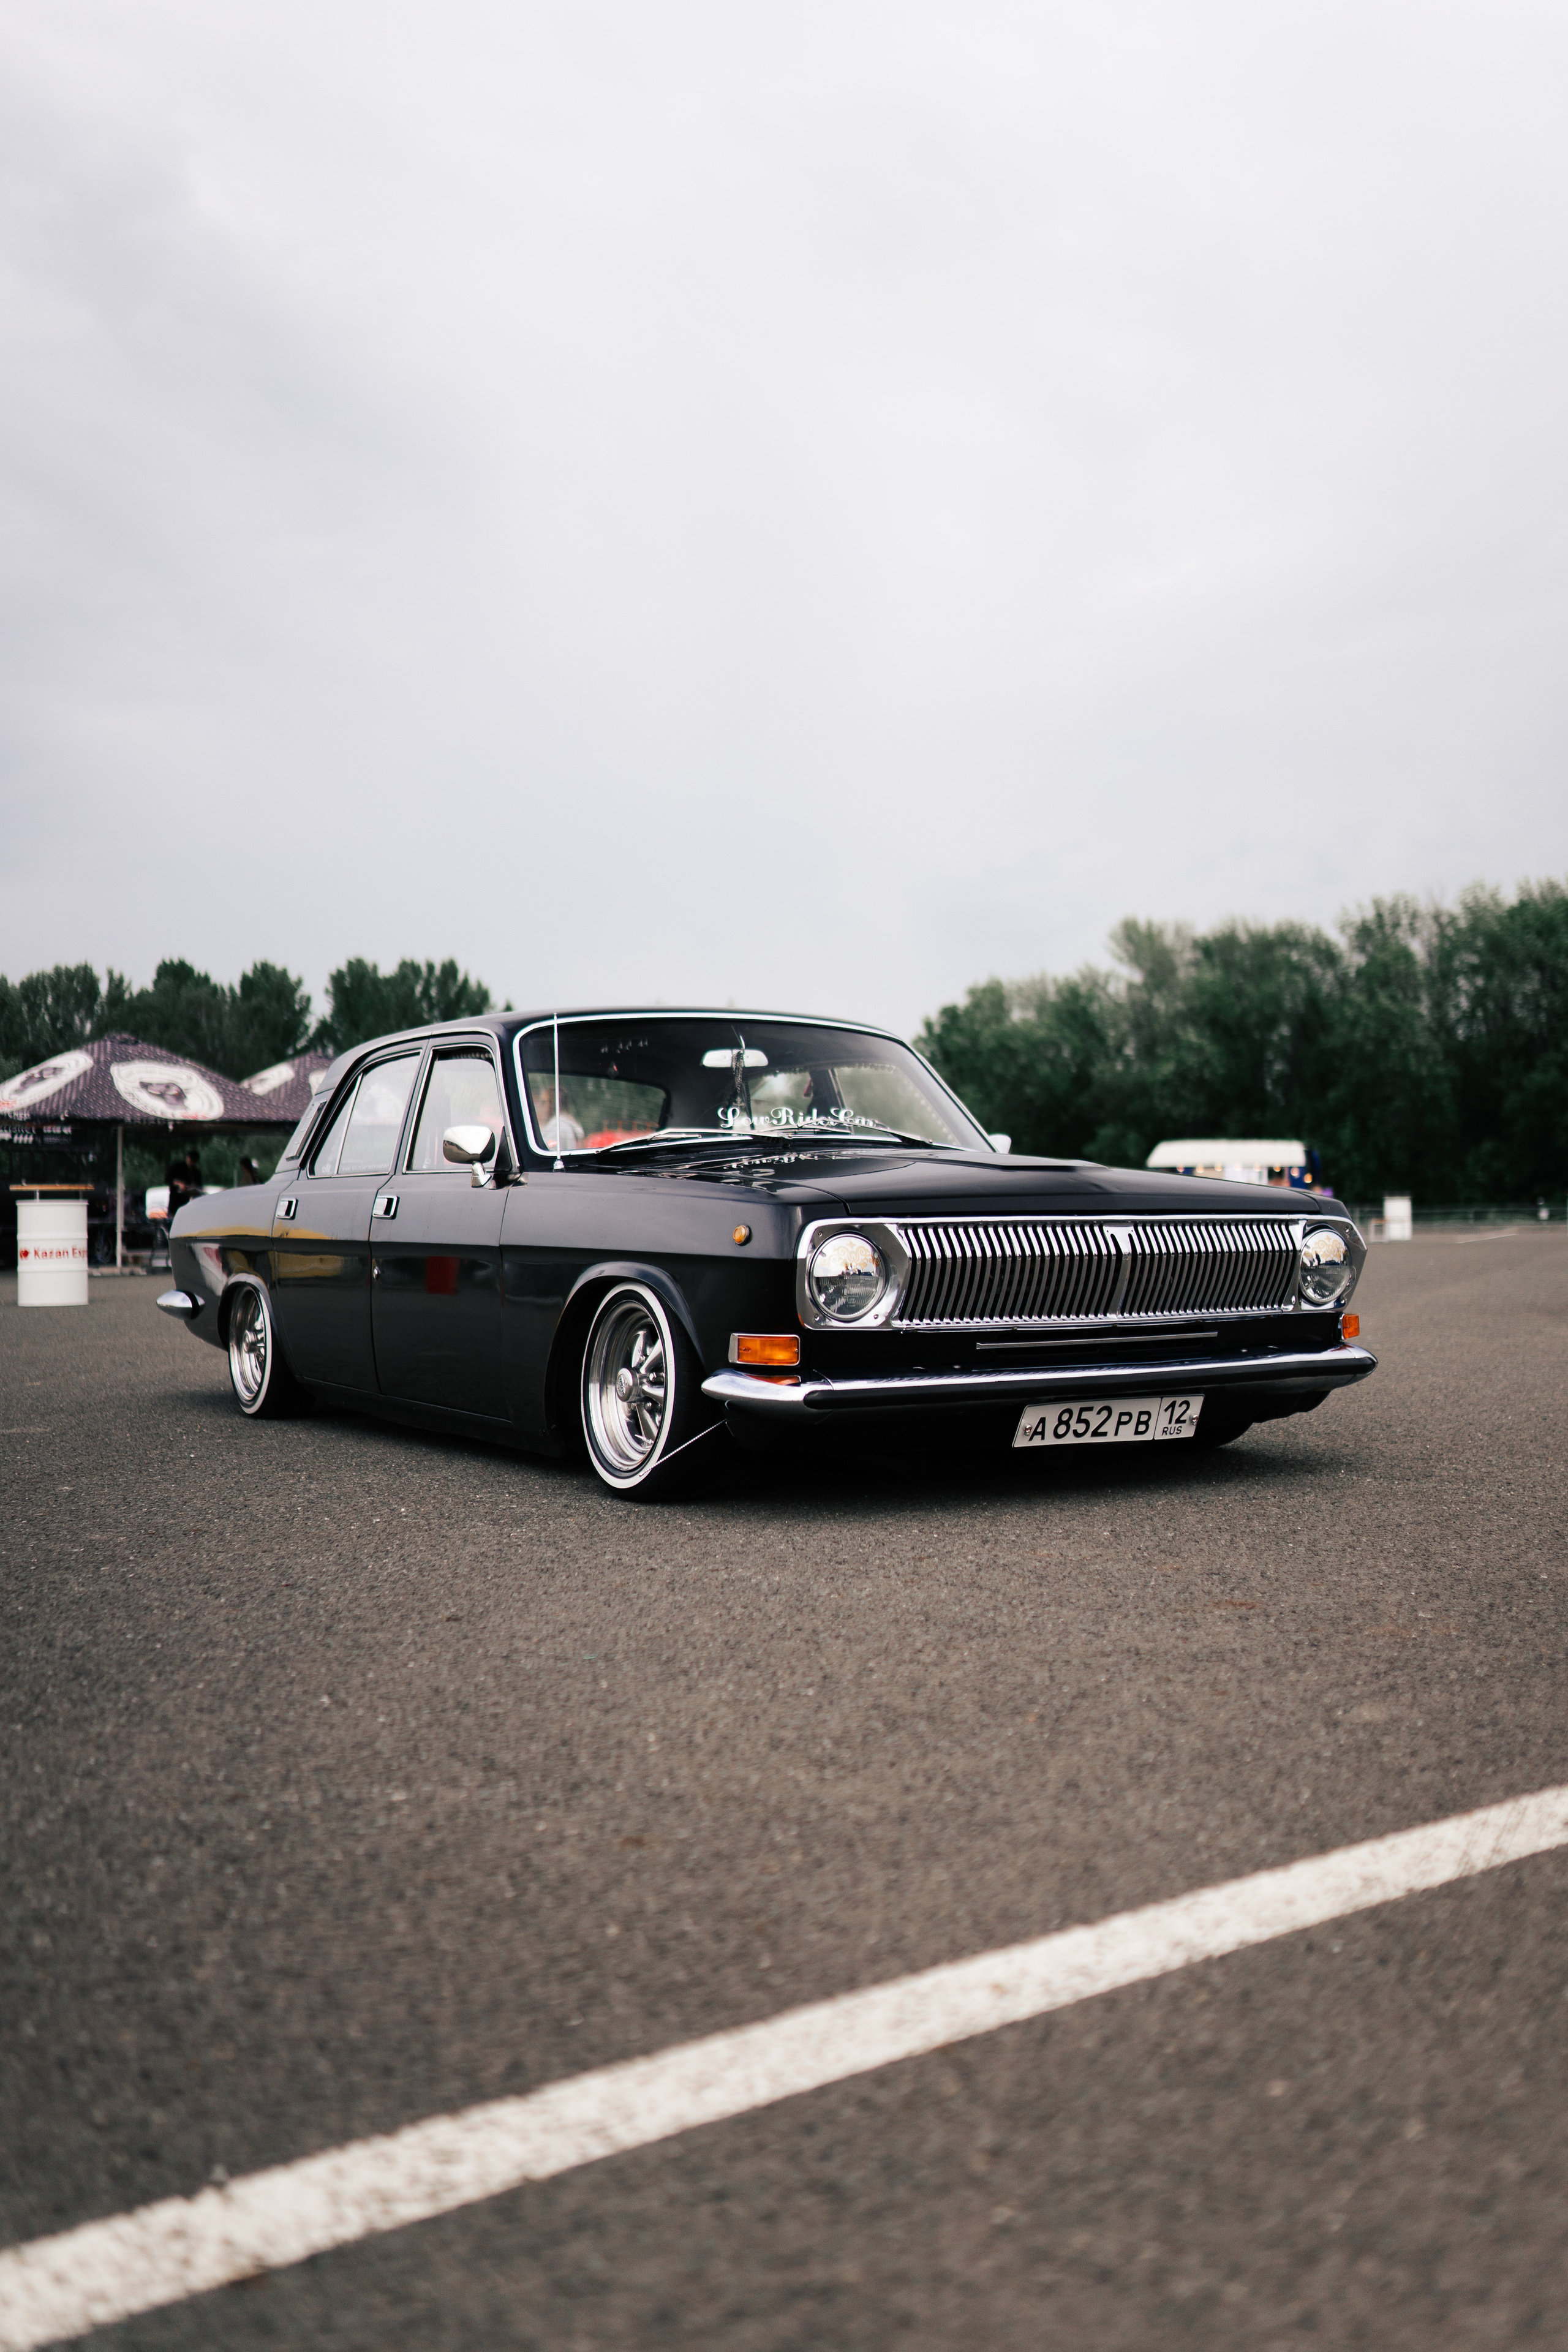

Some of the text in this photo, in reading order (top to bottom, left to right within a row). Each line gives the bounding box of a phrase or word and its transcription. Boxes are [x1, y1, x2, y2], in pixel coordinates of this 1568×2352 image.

[34, 1247, 69, 1260] Kazan
[1164, 1400, 1191, 1425] 12
[1162, 1425, 1182, 1436] RUS
